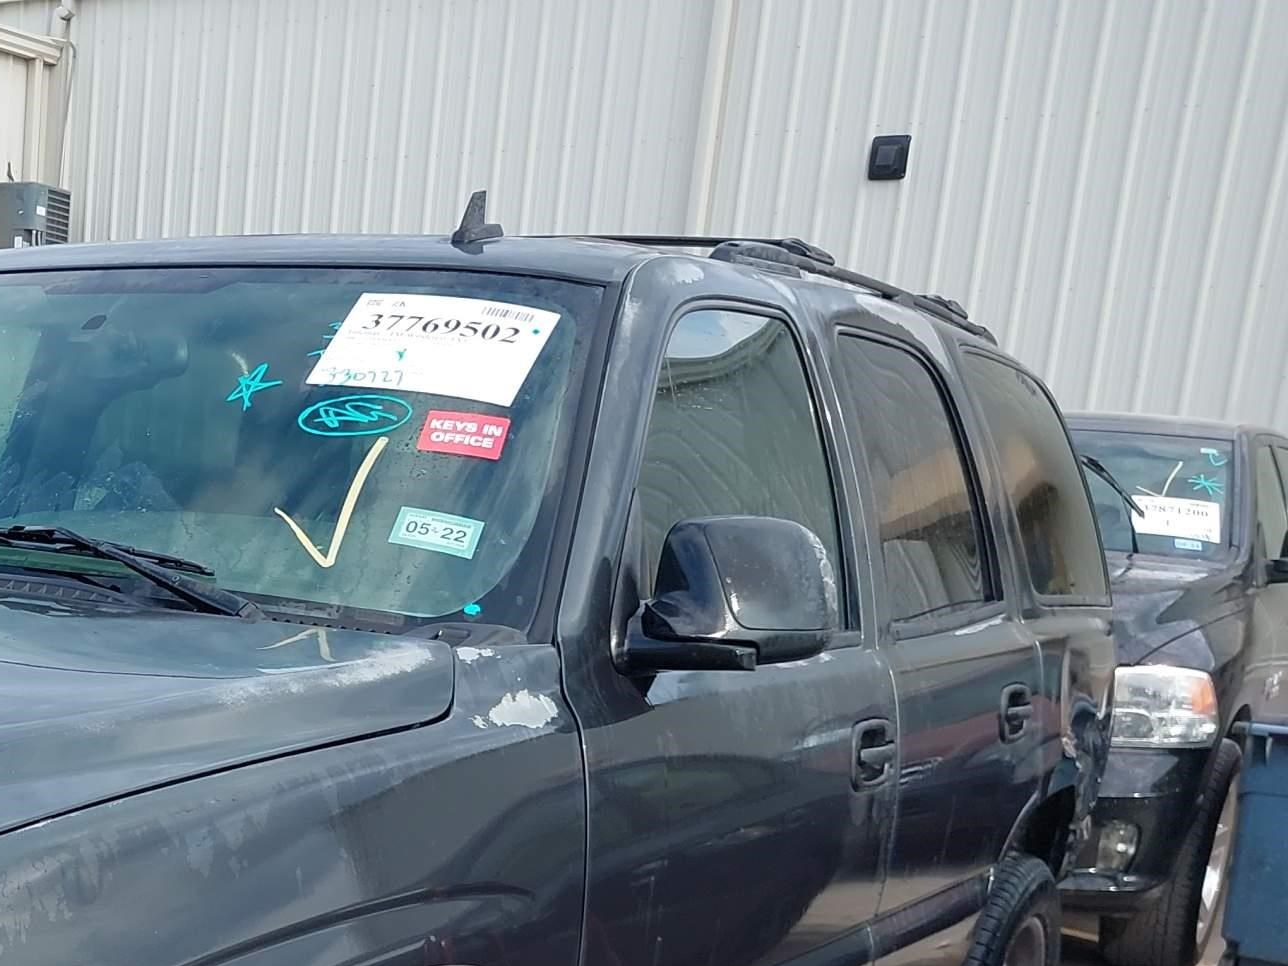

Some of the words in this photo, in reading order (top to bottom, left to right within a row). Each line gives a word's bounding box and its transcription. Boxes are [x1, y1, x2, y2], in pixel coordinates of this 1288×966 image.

[362, 313, 521, 344] 37769502
[430, 418, 478, 434] KEYS
[482, 423, 504, 437] IN
[430, 431, 495, 449] OFFICE
